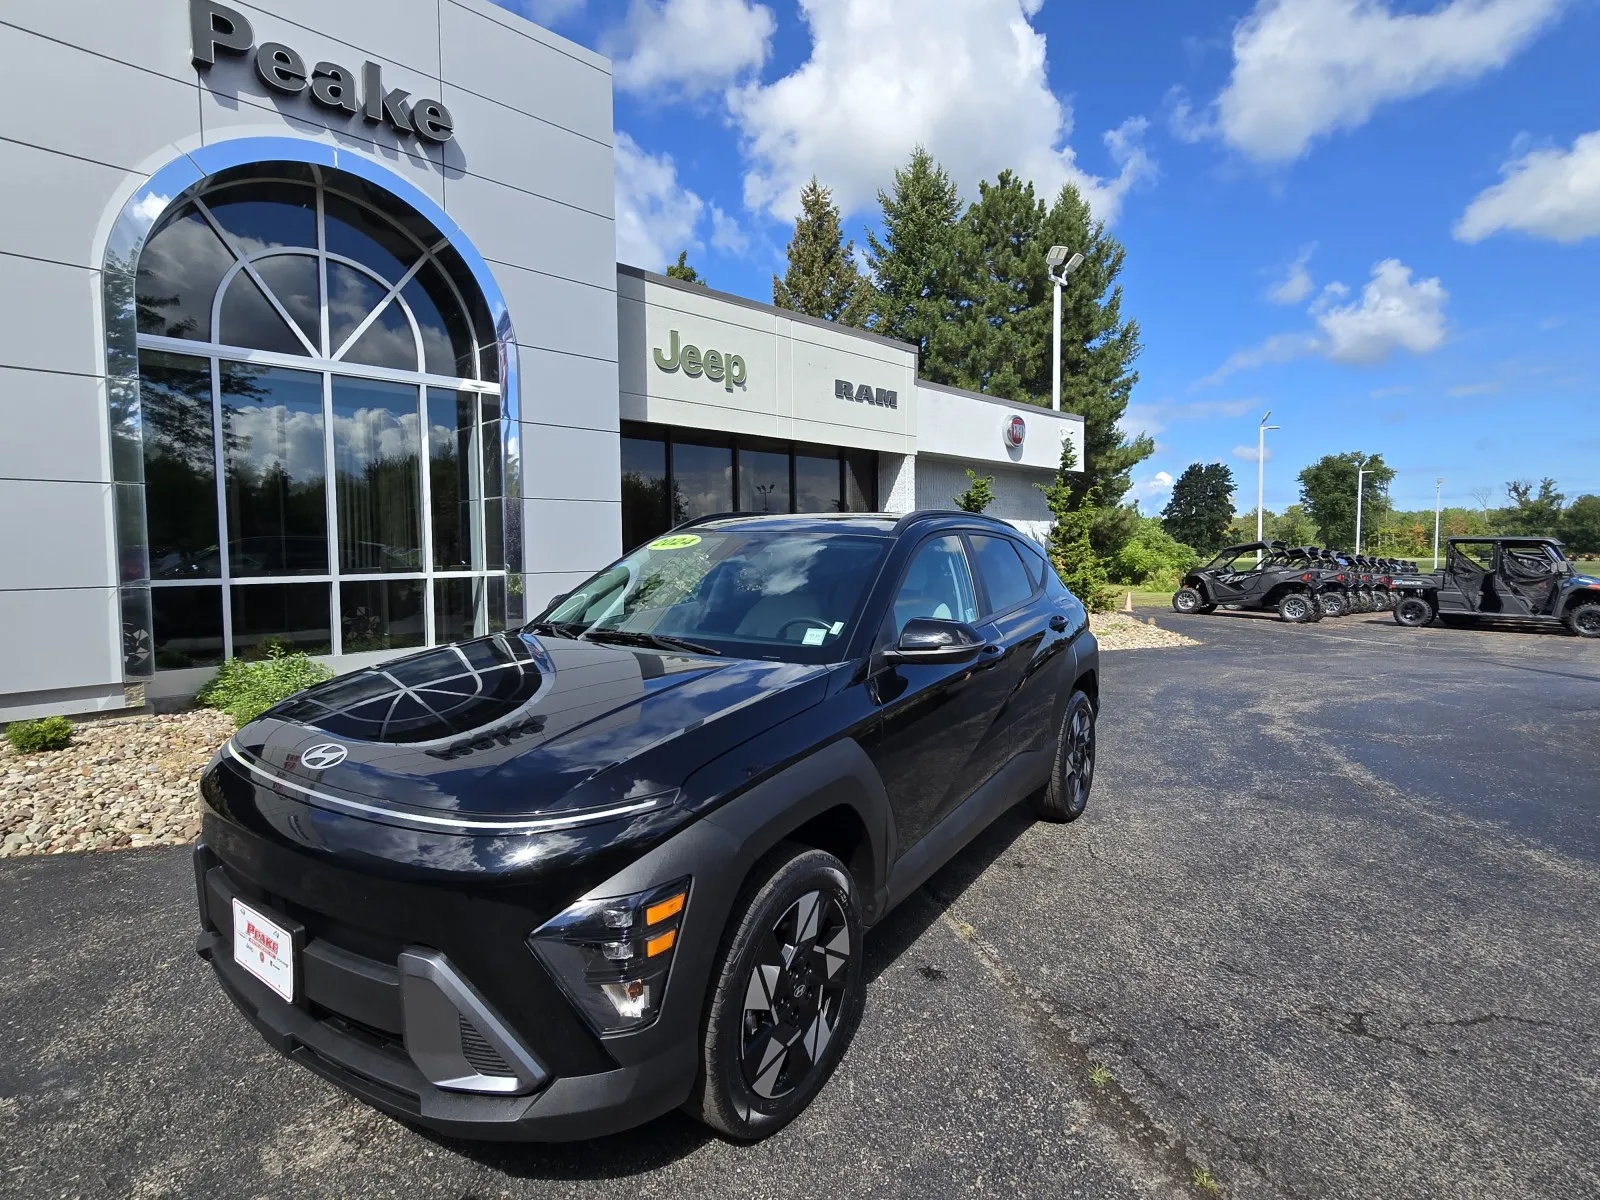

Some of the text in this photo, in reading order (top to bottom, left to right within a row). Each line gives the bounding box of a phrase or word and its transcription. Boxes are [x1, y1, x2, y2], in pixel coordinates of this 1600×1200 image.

[189, 0, 454, 143] Peake
[653, 330, 746, 391] Jeep
[835, 379, 898, 408] RAM
